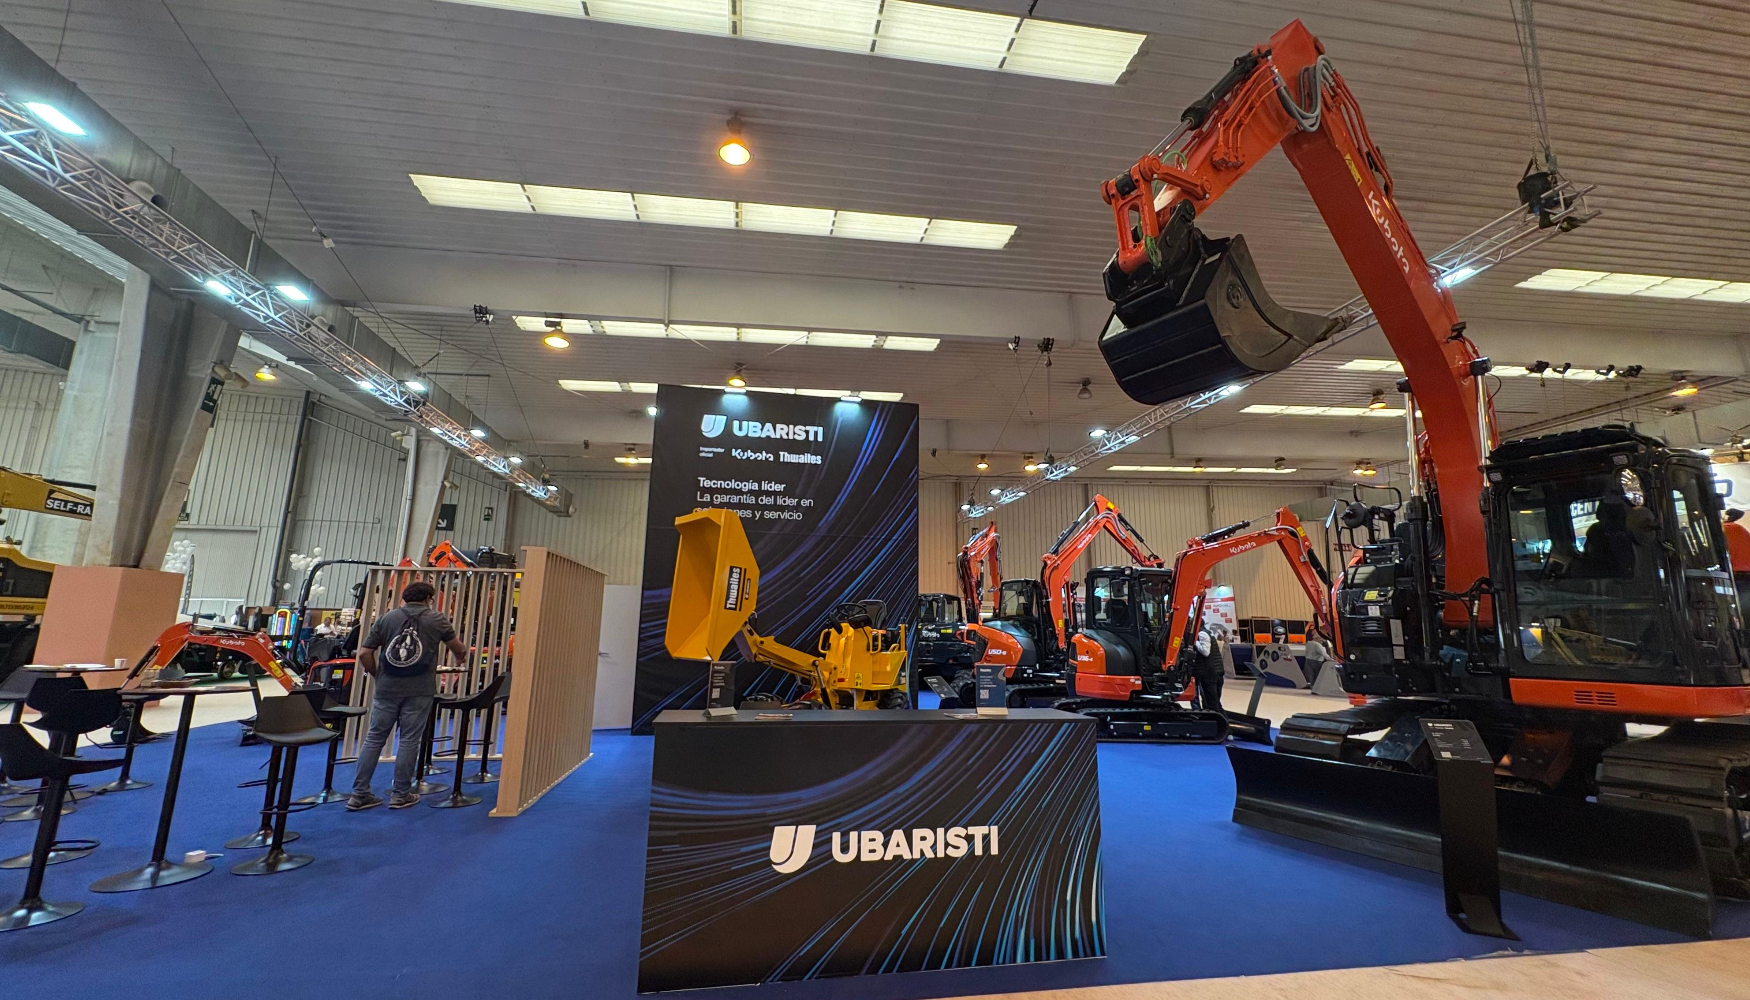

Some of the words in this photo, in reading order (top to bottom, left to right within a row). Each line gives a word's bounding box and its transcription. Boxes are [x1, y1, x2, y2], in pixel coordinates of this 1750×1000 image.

[1368, 190, 1410, 274] Kubota
[732, 420, 824, 442] UBARISTI
[731, 448, 774, 462] Kubota
[779, 451, 822, 465] Thwaites
[698, 477, 758, 492] Tecnología
[761, 480, 786, 492] líder
[697, 491, 711, 502] La
[713, 493, 756, 504] garantía
[758, 495, 774, 505] del
[776, 495, 799, 506] líder
[800, 498, 814, 507] en
[754, 510, 761, 520] y
[763, 510, 803, 520] servicio
[1229, 541, 1257, 554] Kubota
[726, 567, 741, 609] Thwaites
[831, 825, 999, 863] UBARISTI
